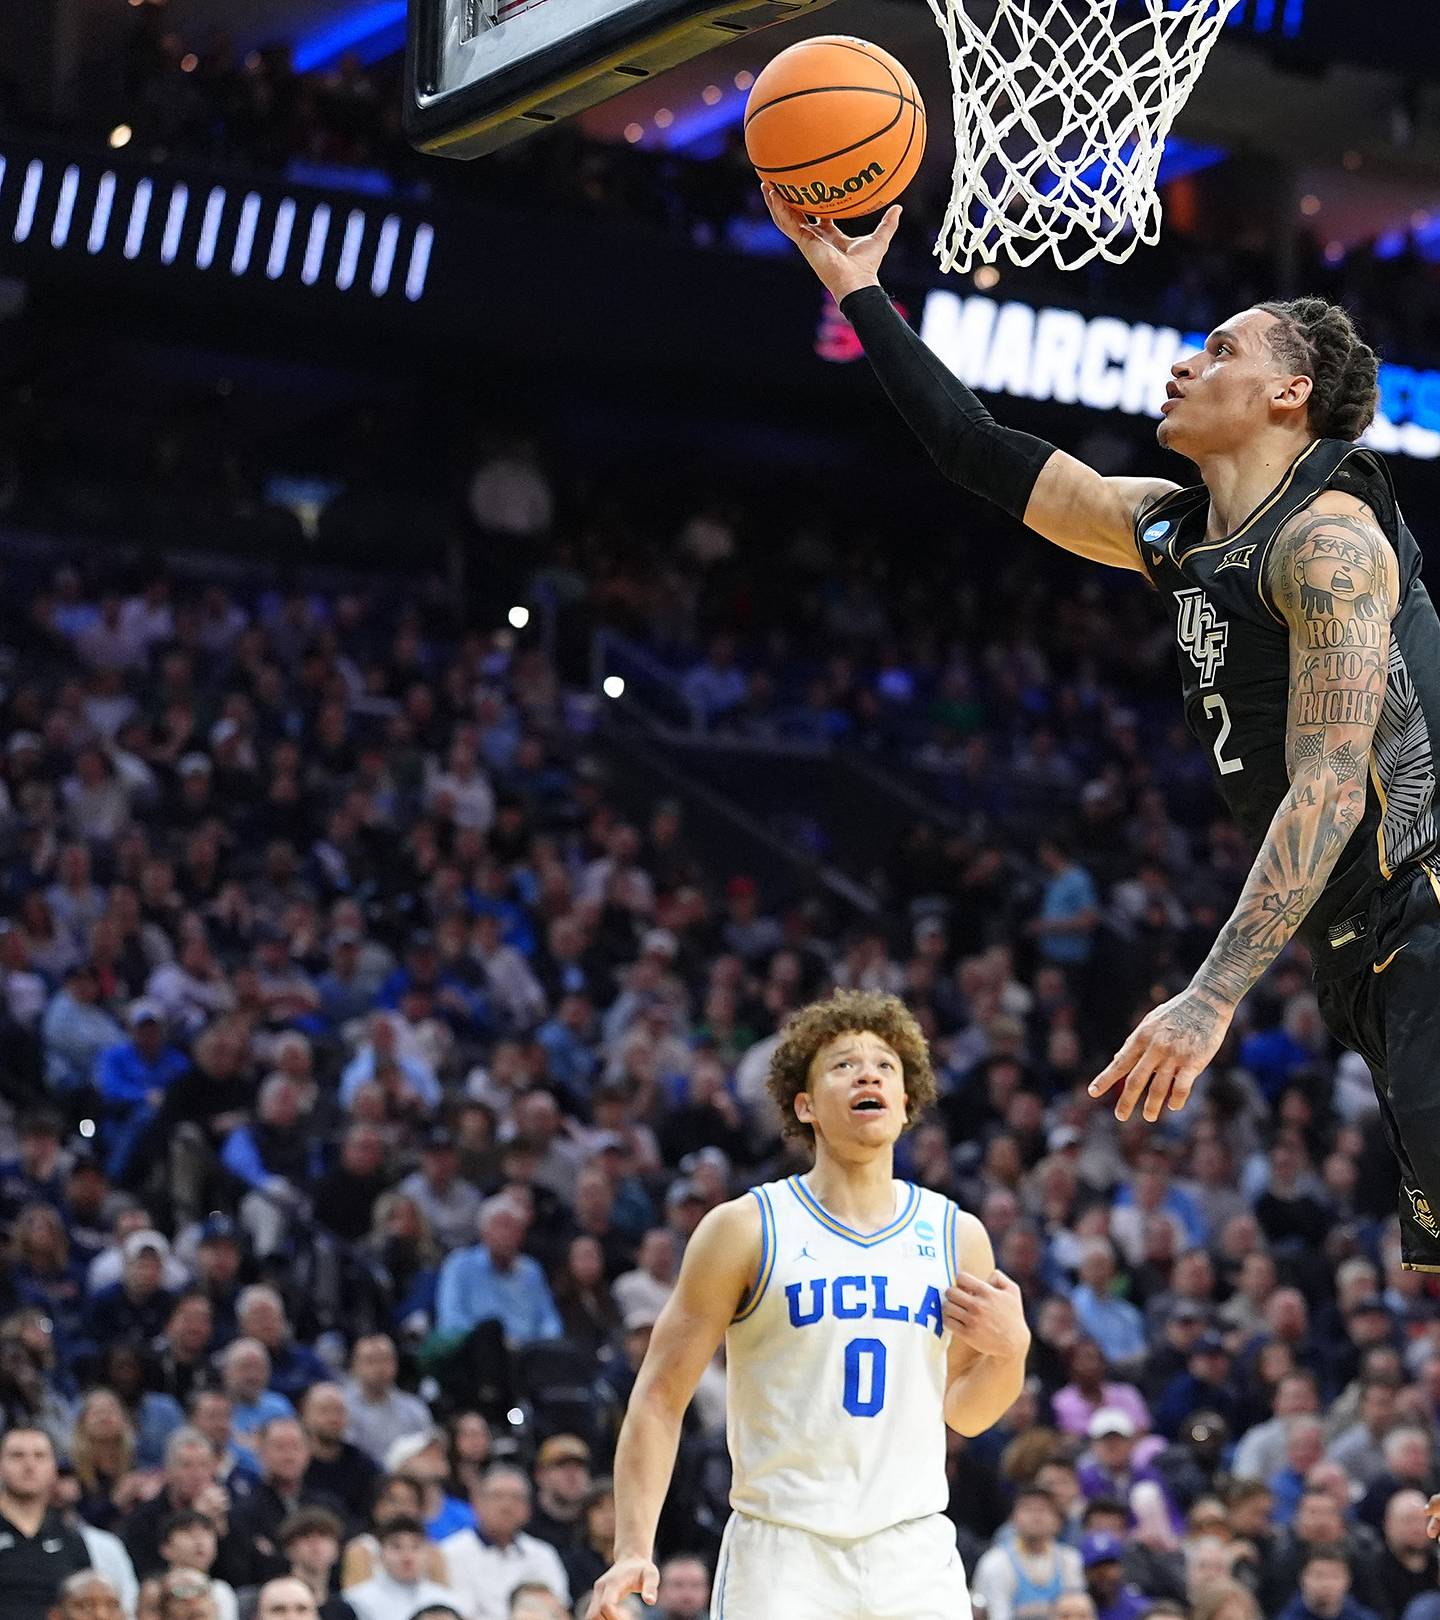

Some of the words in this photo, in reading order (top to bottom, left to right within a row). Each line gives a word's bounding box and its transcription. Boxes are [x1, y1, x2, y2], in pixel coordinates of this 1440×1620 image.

[769, 161, 885, 205] Wilson
[921, 289, 1183, 419] MARCH
[1312, 538, 1368, 565] RARE
[1173, 587, 1228, 688] UCF
[1305, 618, 1381, 649] ROAD
[1324, 651, 1362, 681] TO
[1203, 693, 1244, 775] 2
[1297, 689, 1380, 727] RICHES
[785, 1275, 944, 1339] UCLA
[843, 1338, 887, 1418] 0
